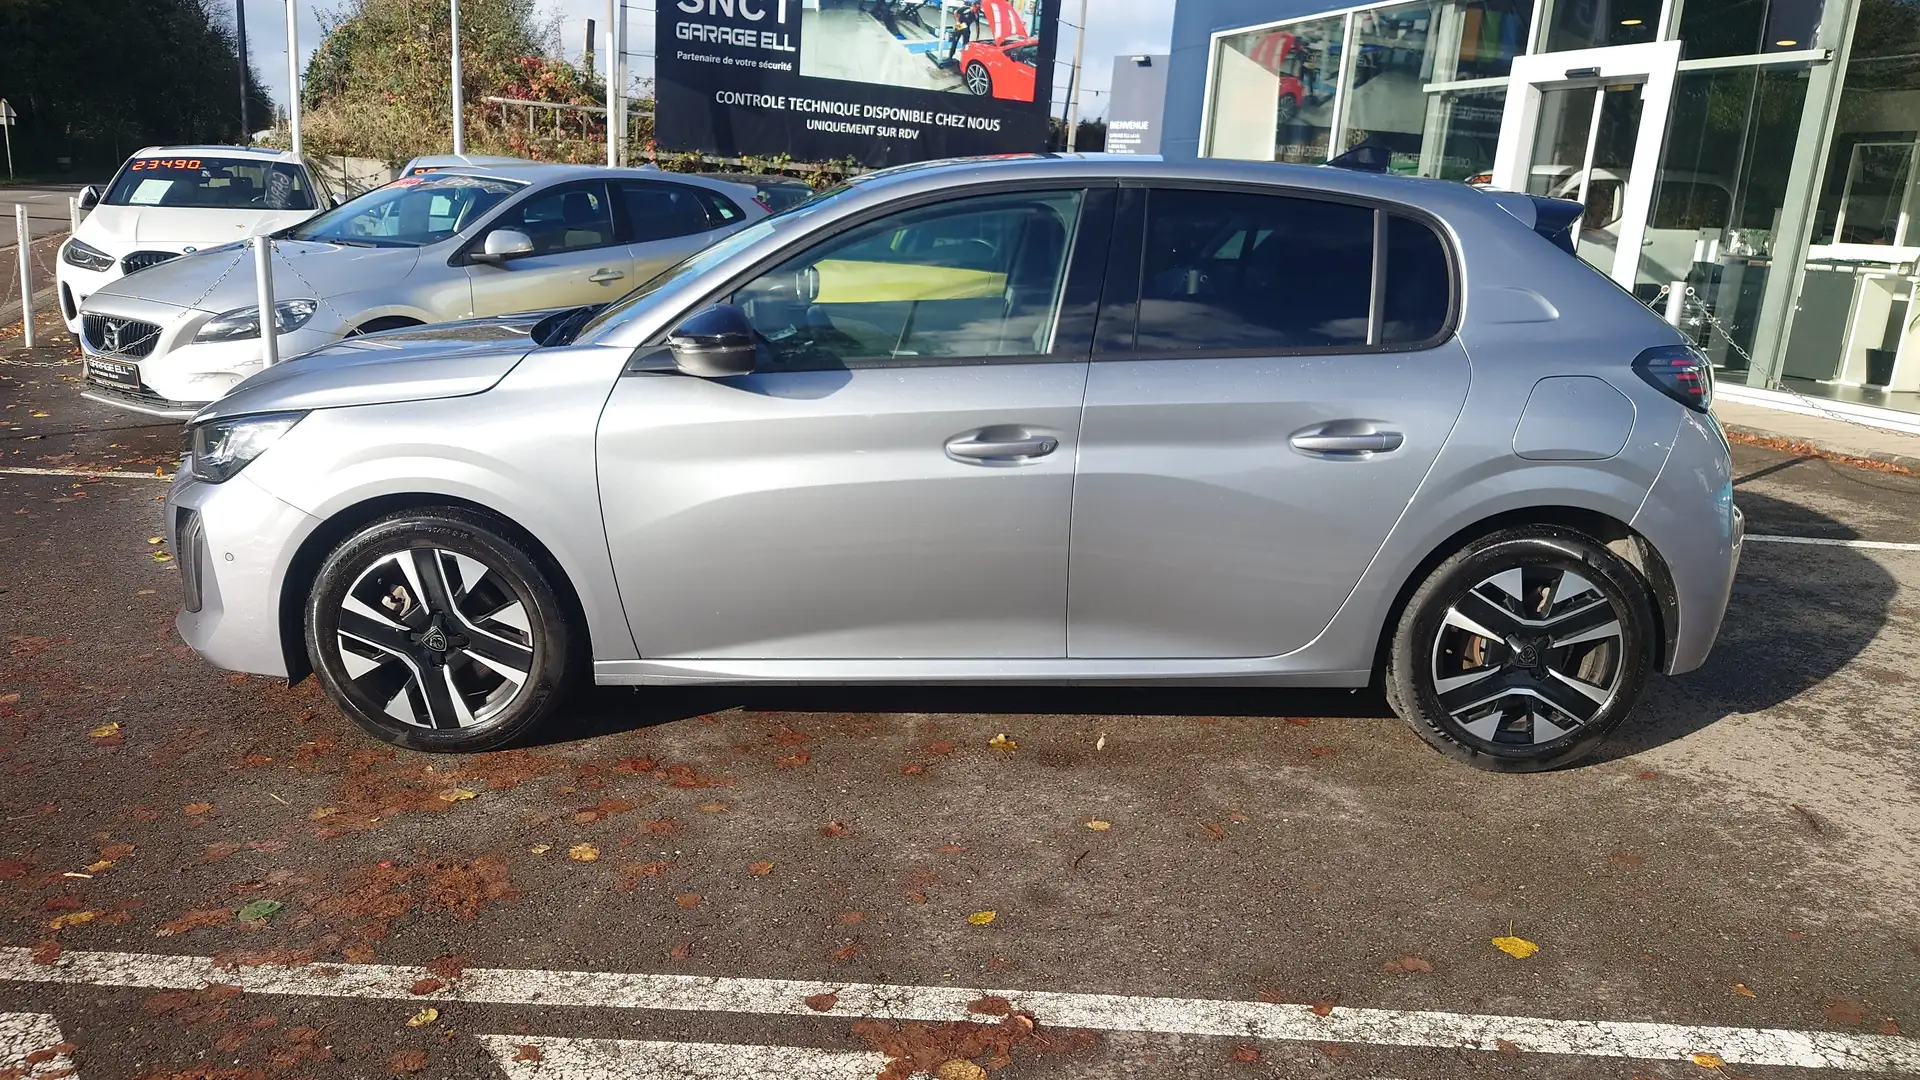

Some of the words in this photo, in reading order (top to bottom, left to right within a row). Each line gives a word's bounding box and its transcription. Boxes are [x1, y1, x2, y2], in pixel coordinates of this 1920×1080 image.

[676, 22, 757, 47] GARAGE
[760, 31, 796, 52] ELL
[677, 51, 720, 63] Partenaire
[722, 56, 733, 65] de
[735, 59, 756, 67] votre
[759, 61, 792, 71] sécurité
[715, 90, 786, 109] CONTROLE
[788, 97, 861, 117] TECHNIQUE
[863, 105, 934, 124] DISPONIBLE
[935, 113, 965, 128] CHEZ
[967, 116, 1001, 131] NOUS
[806, 119, 876, 135] UNIQUEMENT
[876, 125, 897, 137] SUR
[898, 128, 919, 140] RDV
[132, 159, 201, 171] 23490
